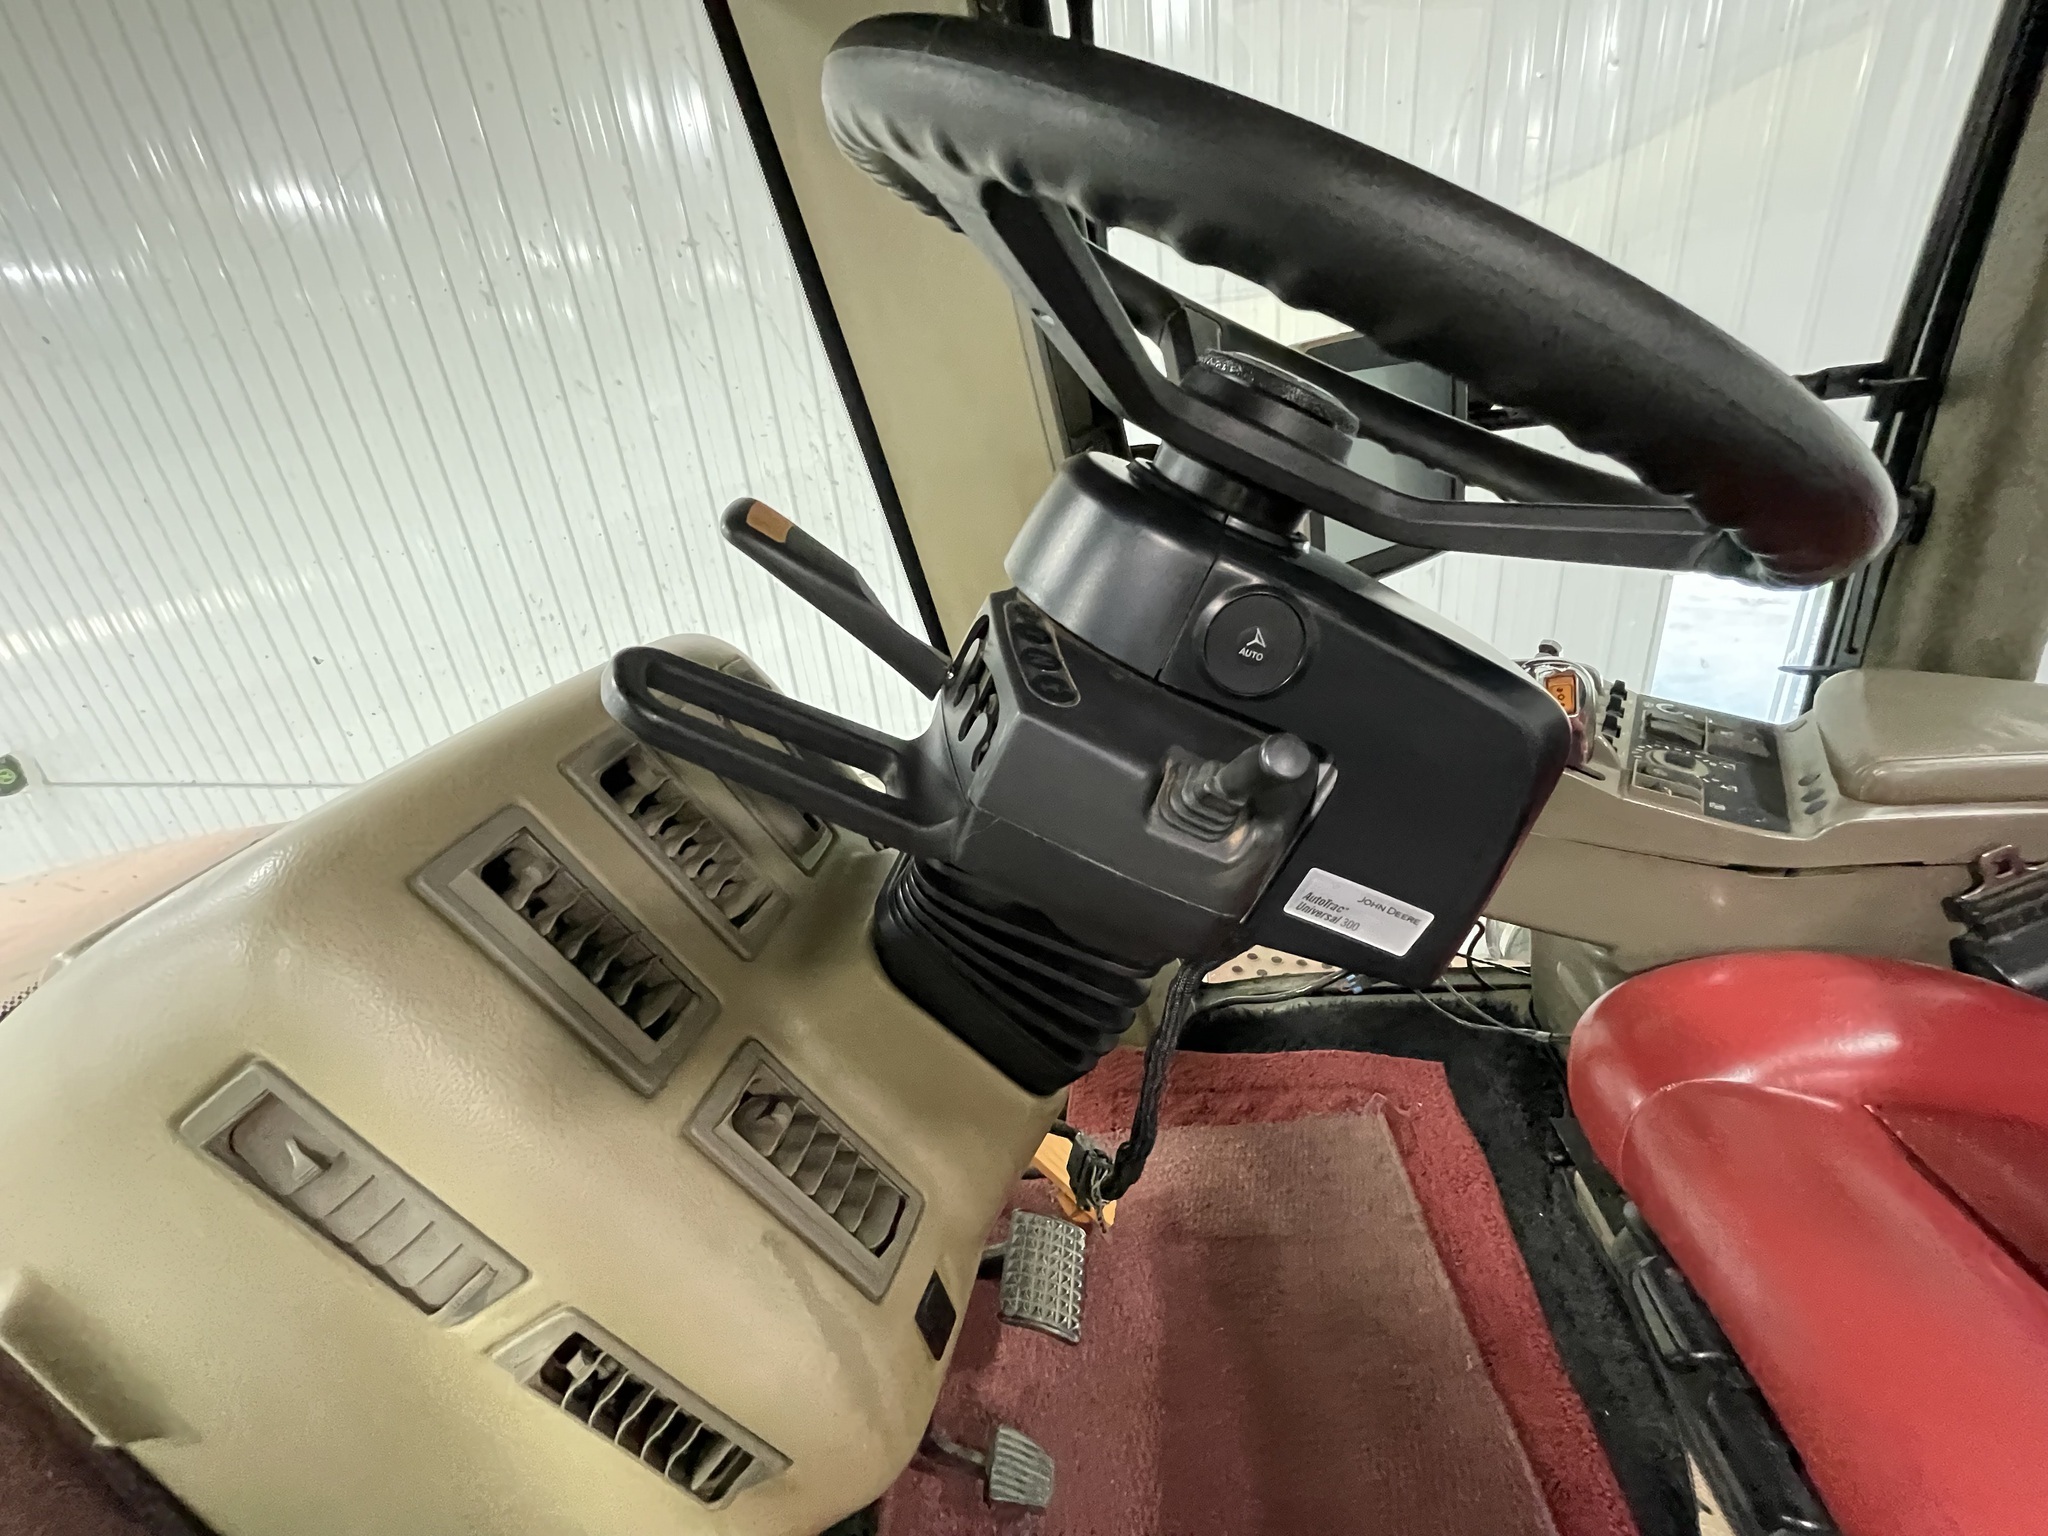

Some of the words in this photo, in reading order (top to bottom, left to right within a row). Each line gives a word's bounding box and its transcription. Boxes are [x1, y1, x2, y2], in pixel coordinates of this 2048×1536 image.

[1238, 647, 1264, 661] AUTO
[1295, 901, 1342, 924] Universal
[1340, 917, 1361, 932] 300
[1357, 897, 1387, 913] JOHN
[1387, 906, 1422, 926] DEERE
